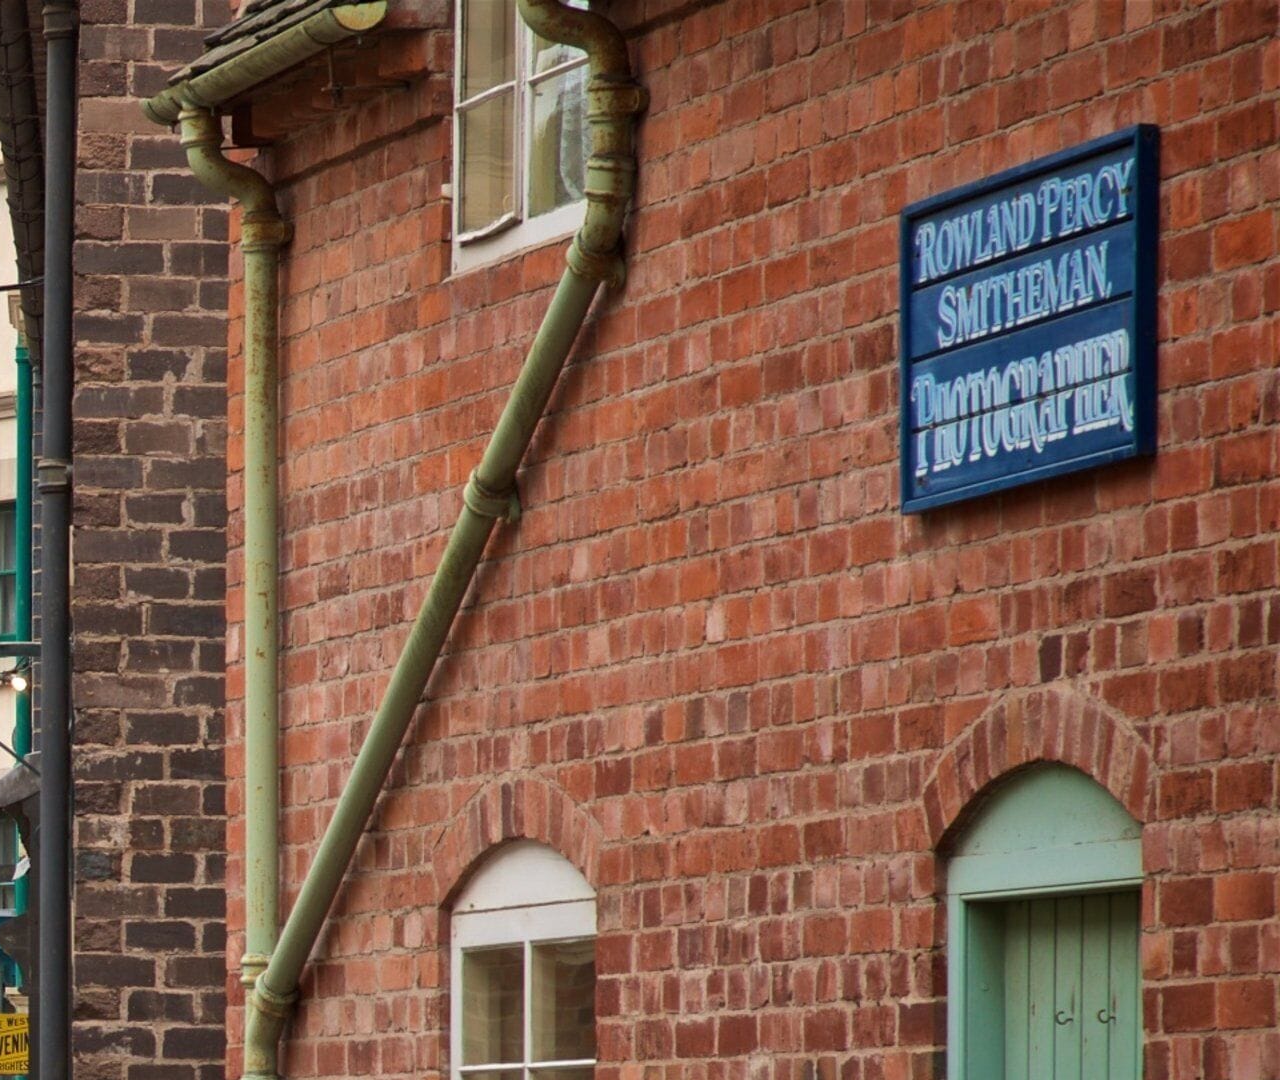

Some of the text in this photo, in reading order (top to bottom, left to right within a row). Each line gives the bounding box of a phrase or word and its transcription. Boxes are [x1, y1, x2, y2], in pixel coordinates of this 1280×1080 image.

[915, 157, 1136, 283] ROWLAND PERCY
[911, 328, 1134, 477] PHOTOGRAPHER
[7, 1016, 29, 1027] WES
